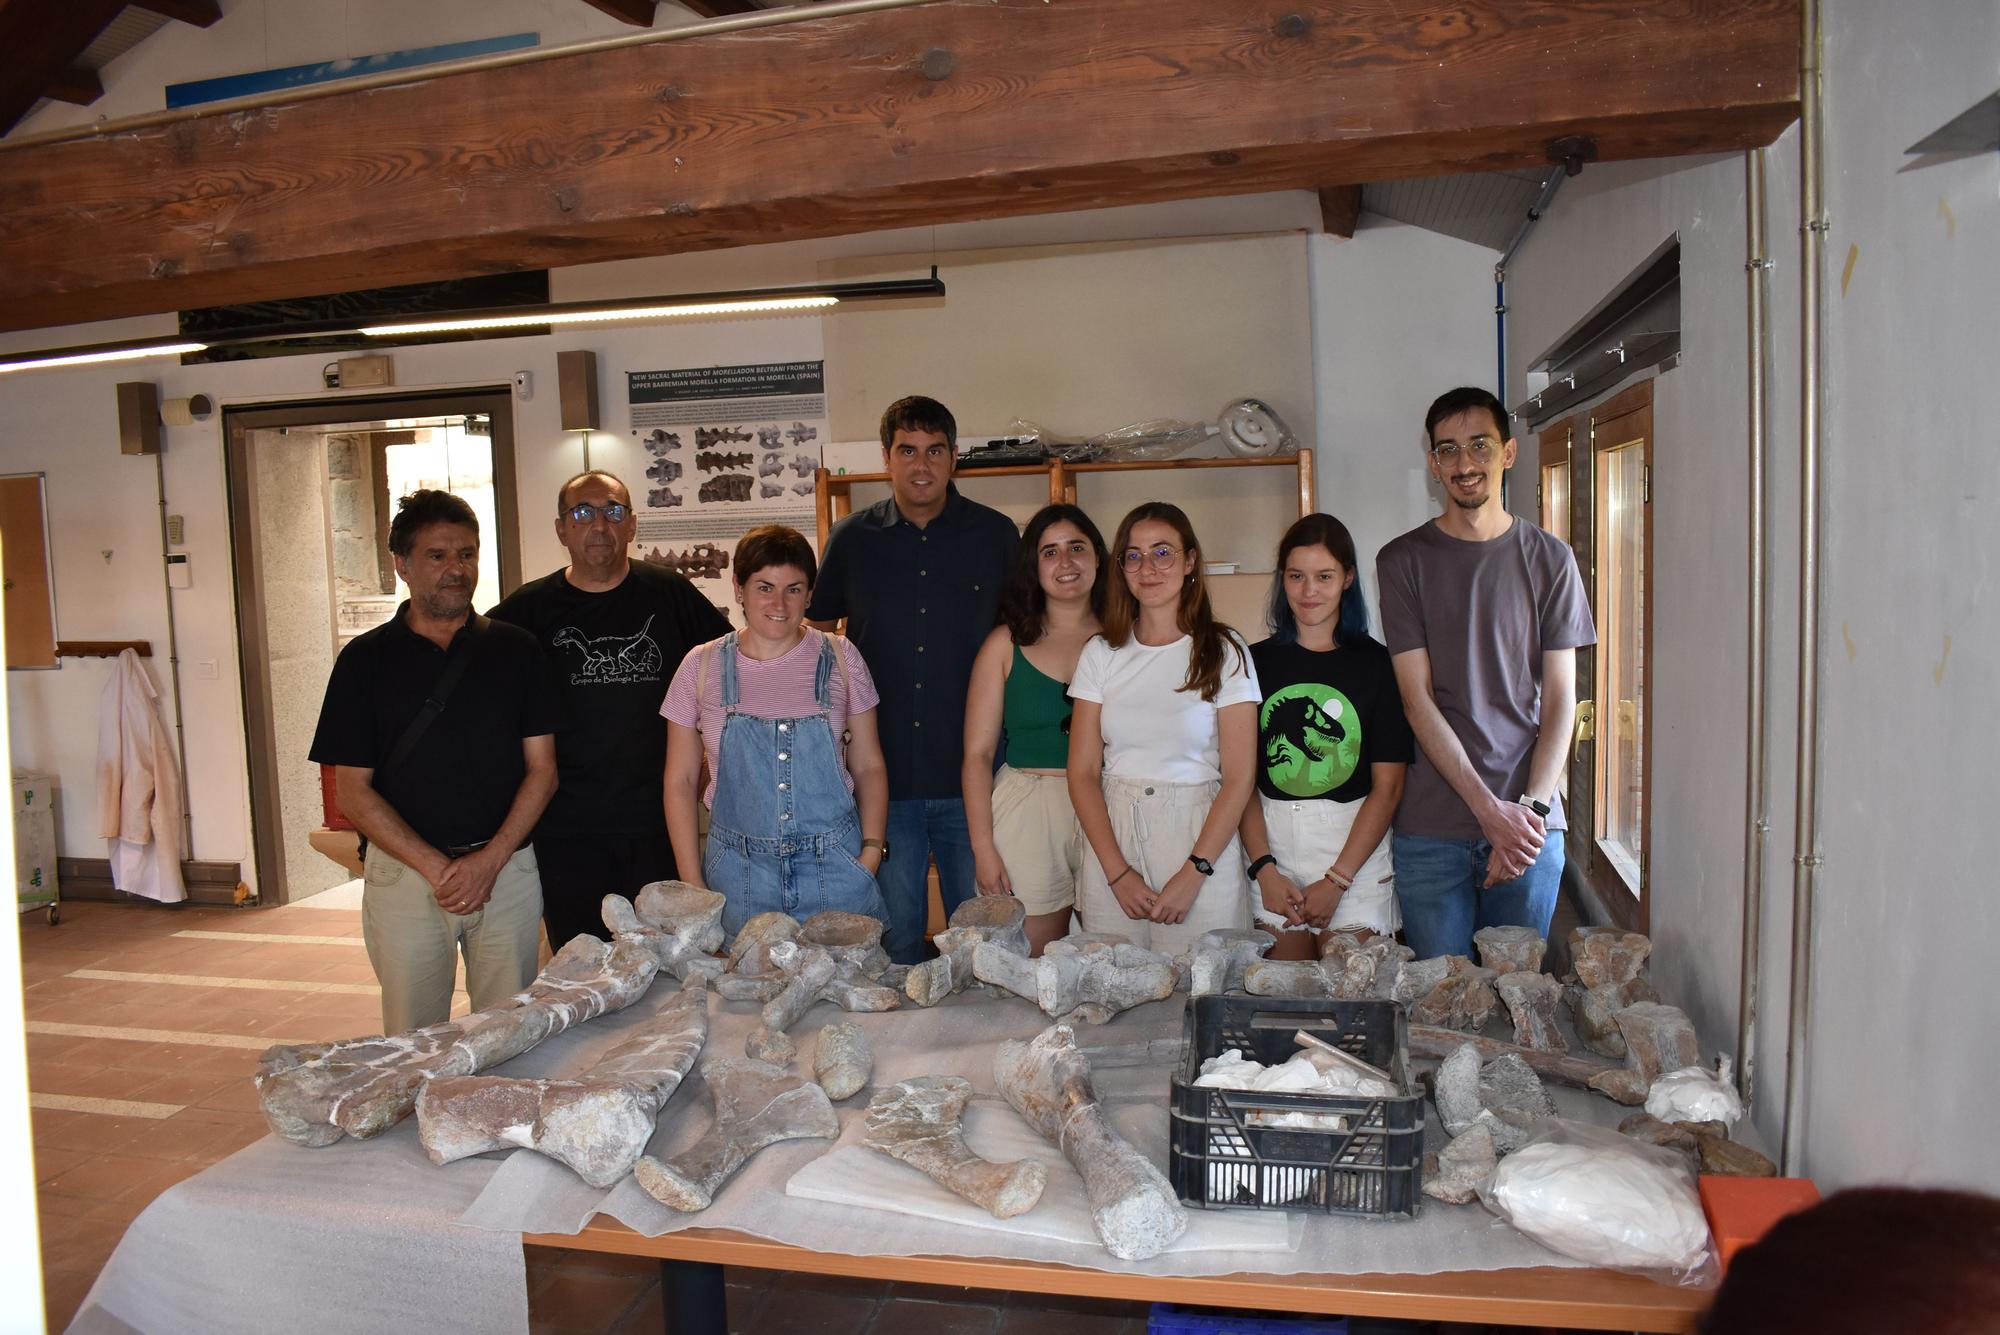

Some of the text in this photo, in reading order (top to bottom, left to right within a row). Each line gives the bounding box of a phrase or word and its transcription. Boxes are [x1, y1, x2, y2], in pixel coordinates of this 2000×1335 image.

[671, 370, 701, 378] MATERIAL
[712, 367, 755, 376] MORELLADON
[756, 365, 785, 373] BELTRANI
[652, 380, 689, 388] BARREMIAN
[689, 378, 719, 386] MORELLA
[719, 376, 757, 384] FORMATION
[796, 372, 820, 380] (SPAIN)
